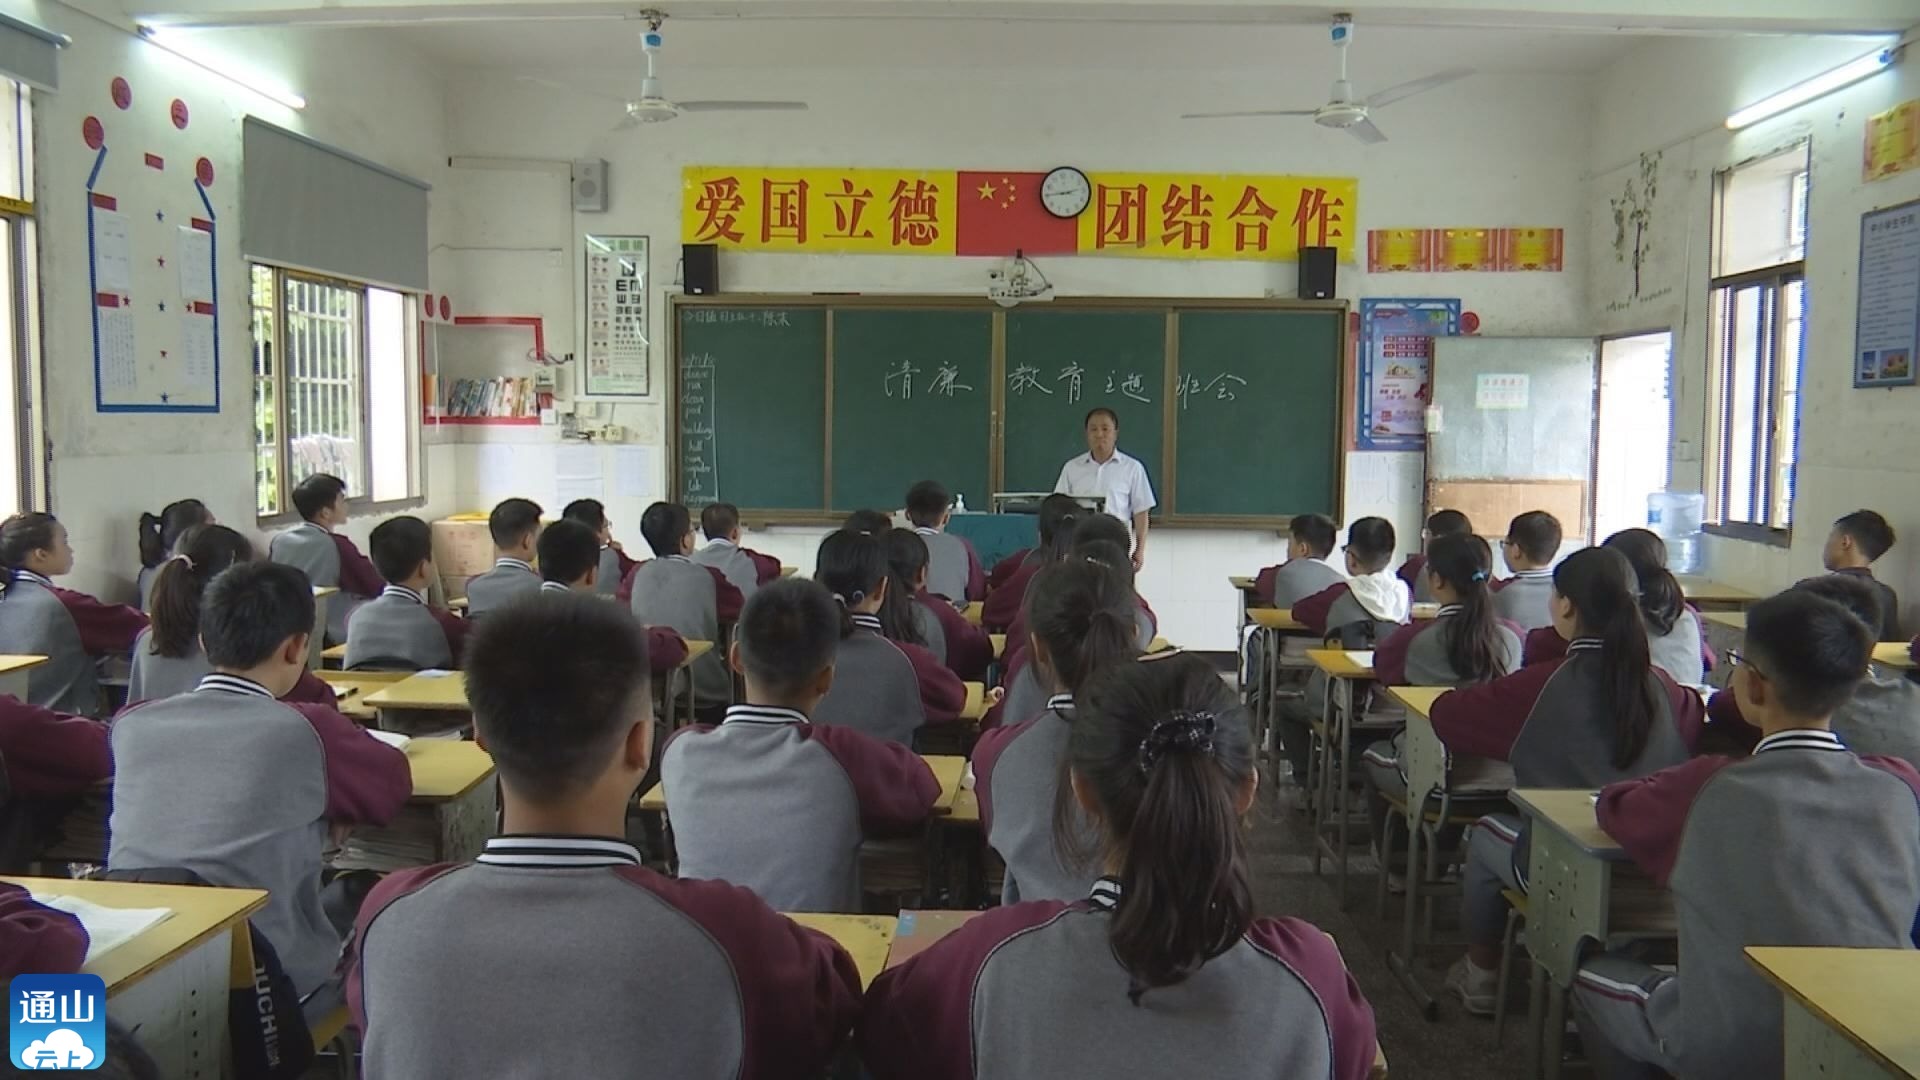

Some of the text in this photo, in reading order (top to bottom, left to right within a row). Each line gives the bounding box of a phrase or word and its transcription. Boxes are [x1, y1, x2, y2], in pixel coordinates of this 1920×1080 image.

[695, 176, 940, 247] 爱国立德
[1096, 183, 1344, 251] 团结合作
